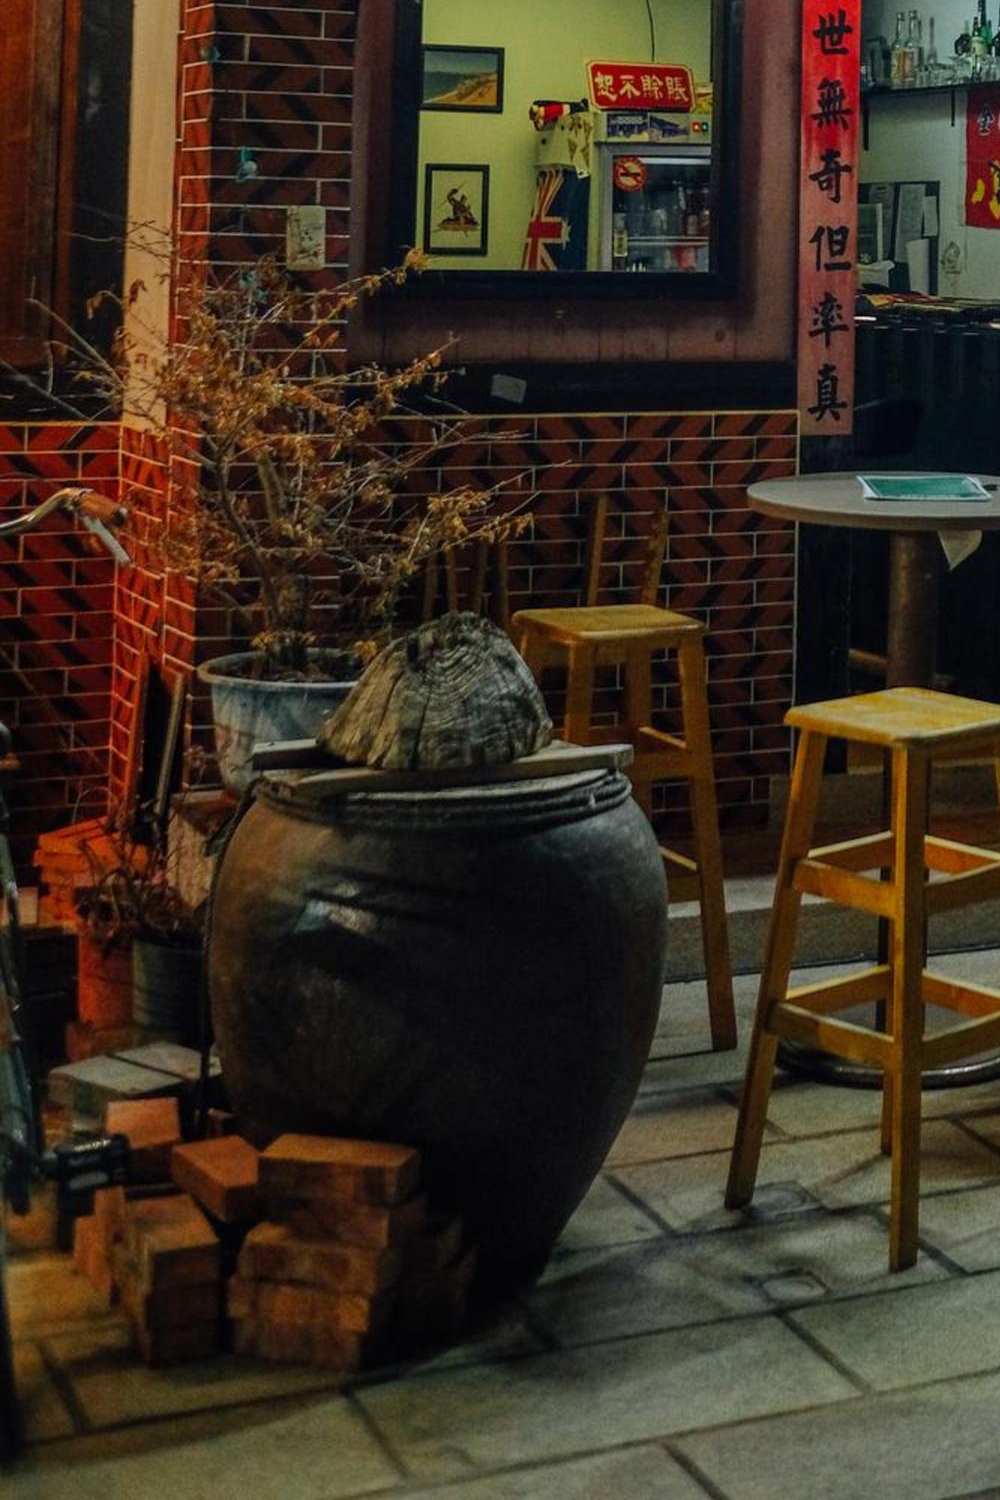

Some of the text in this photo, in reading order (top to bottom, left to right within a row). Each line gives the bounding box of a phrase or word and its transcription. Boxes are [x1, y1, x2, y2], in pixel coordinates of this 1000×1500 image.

[807, 8, 854, 423] 世無奇但率真
